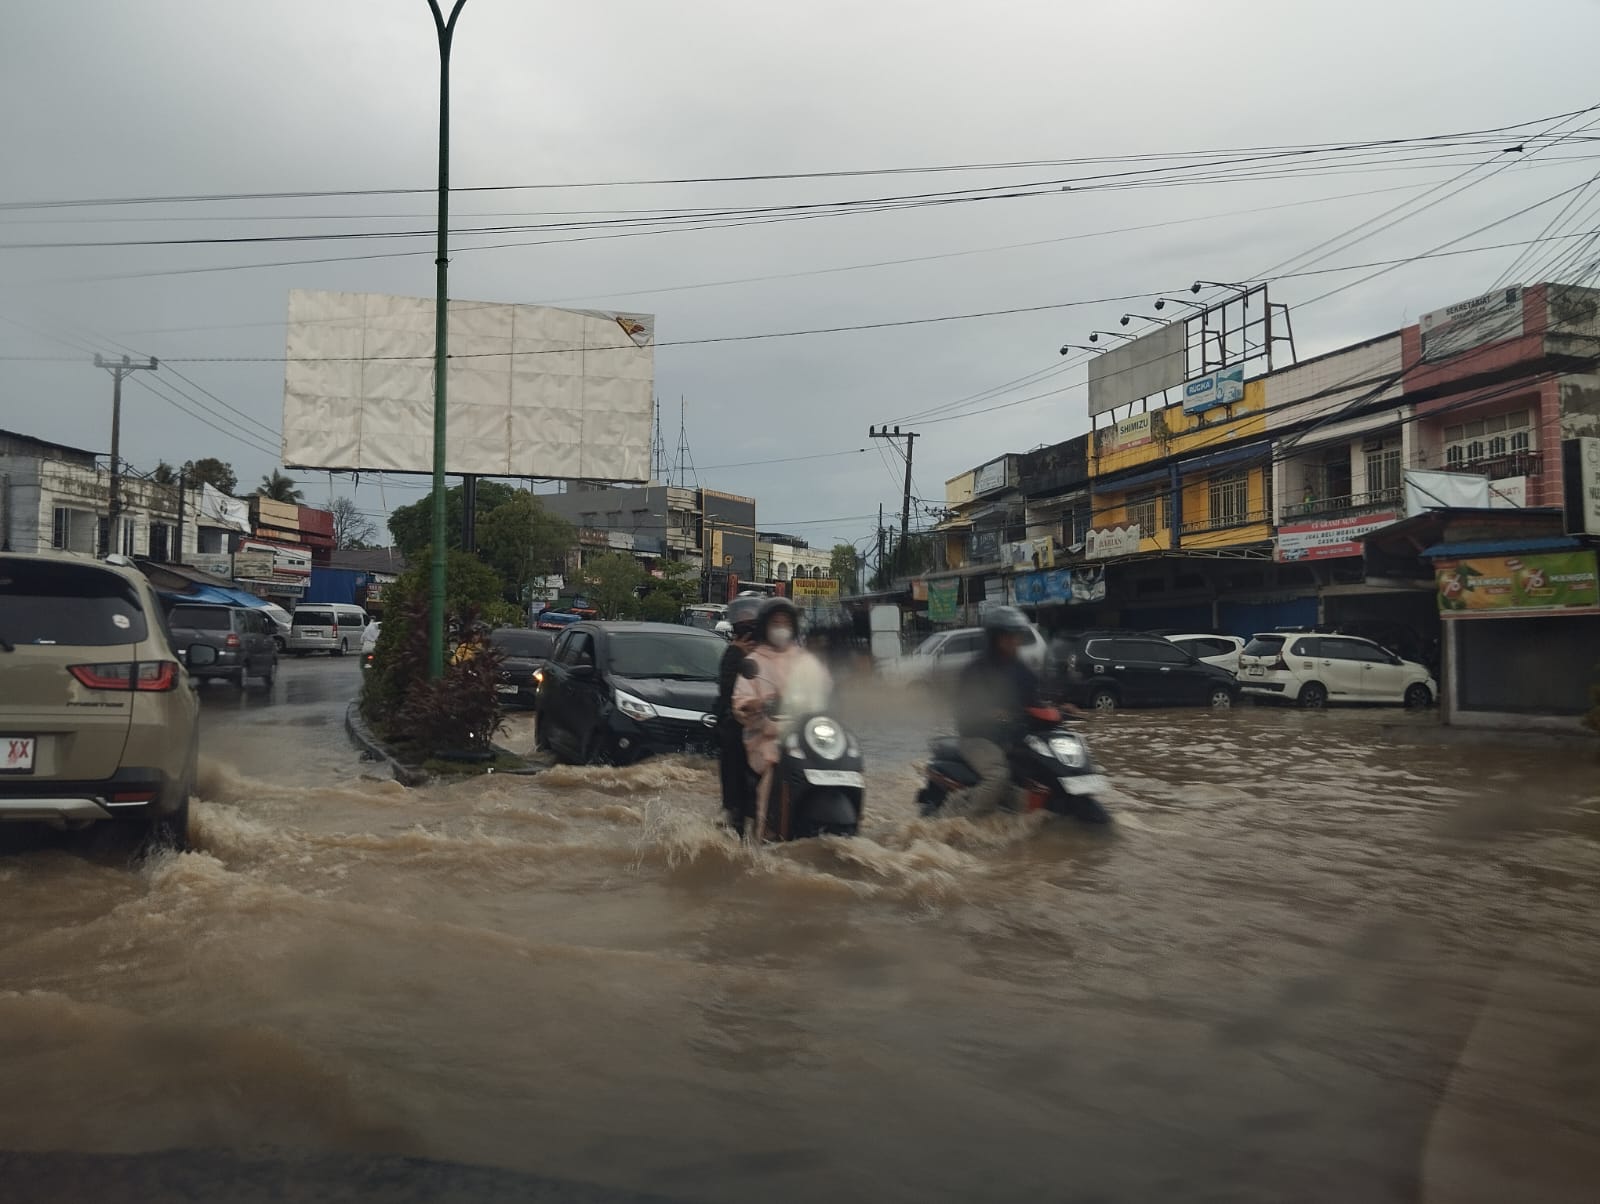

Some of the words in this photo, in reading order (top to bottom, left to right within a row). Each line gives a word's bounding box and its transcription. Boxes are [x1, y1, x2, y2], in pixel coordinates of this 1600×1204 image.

[1446, 295, 1490, 316] SEKRETARIAT
[1119, 418, 1149, 434] SHIMIZU
[1305, 531, 1319, 541] JUAL
[1321, 530, 1334, 538] BELI
[1336, 527, 1355, 536] MOBIL
[1318, 536, 1334, 545] CASH
[1467, 578, 1512, 587] MANGGA
[1550, 573, 1593, 582] MANGGA
